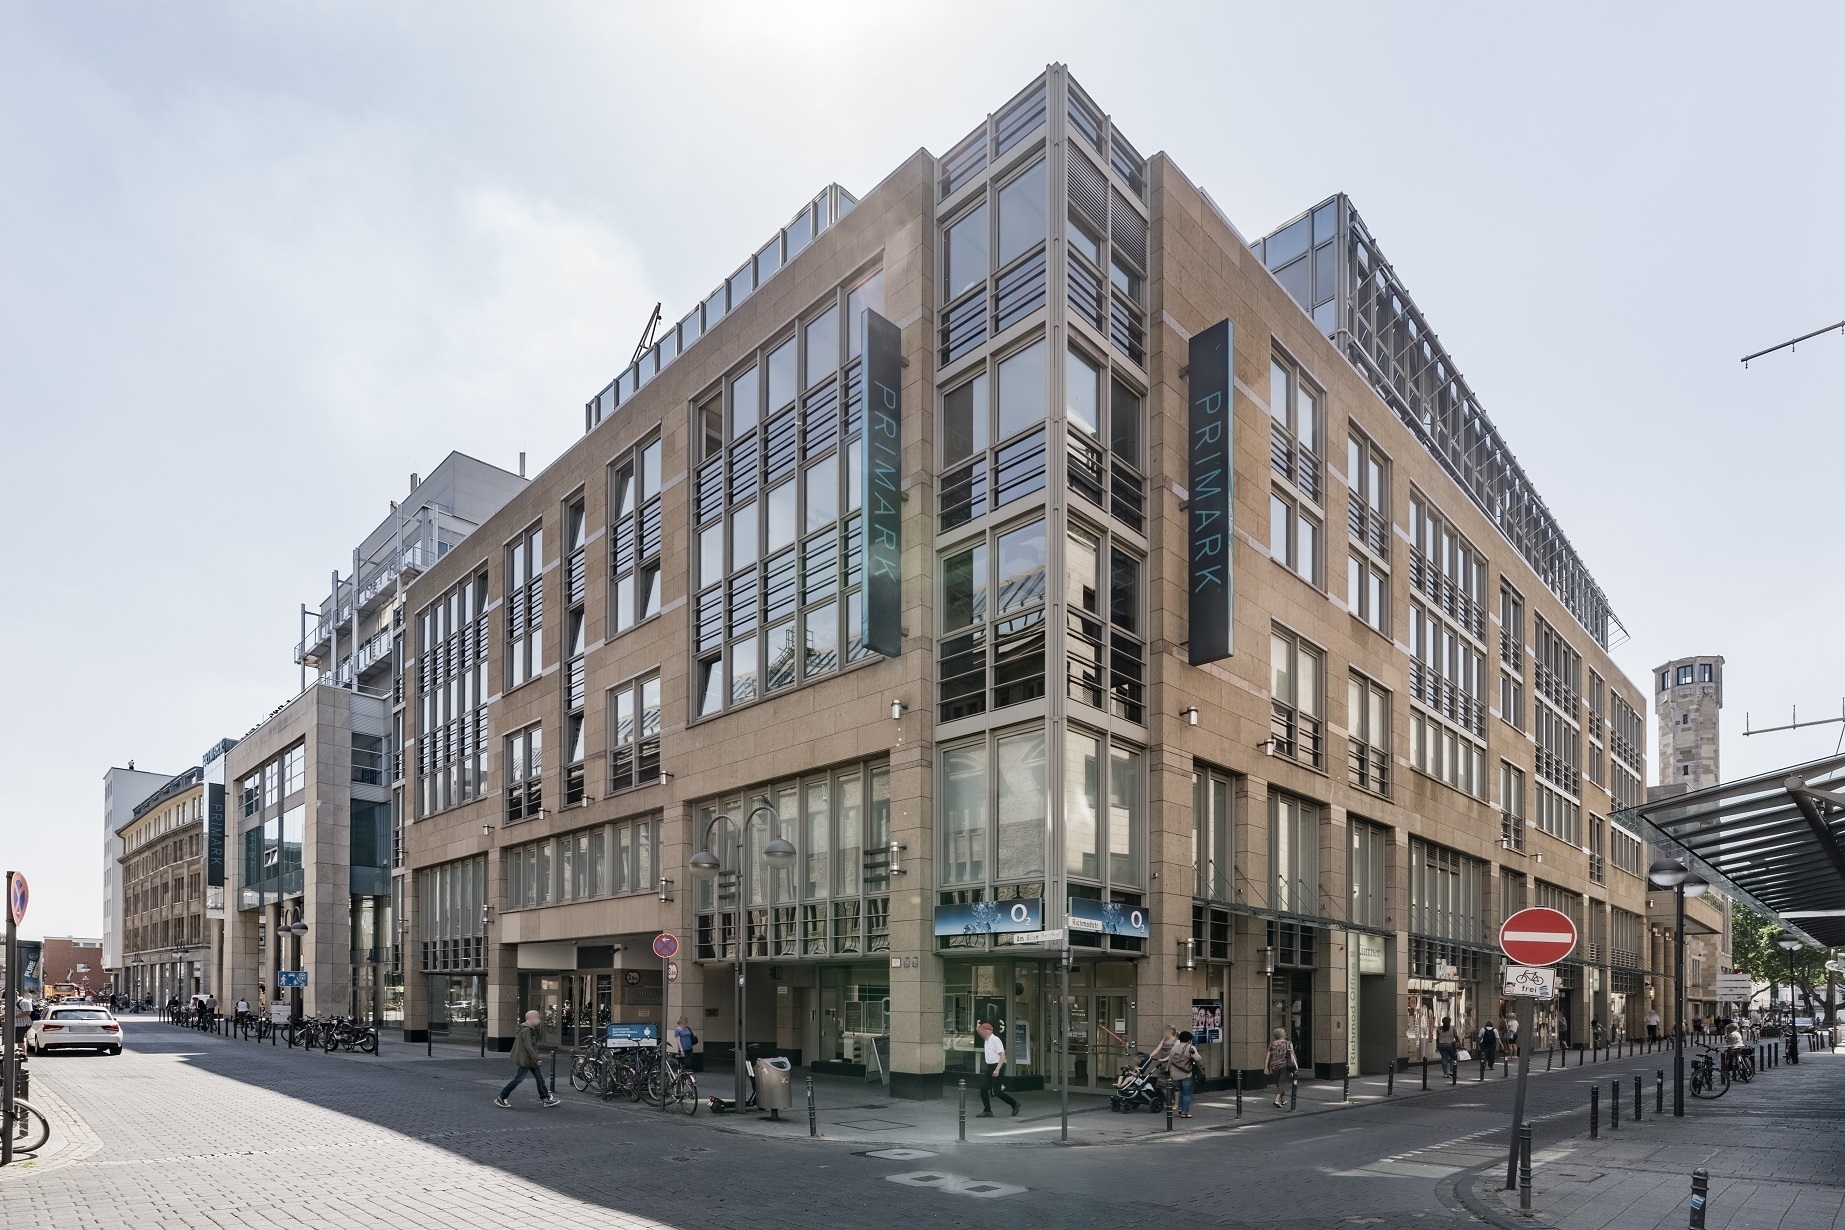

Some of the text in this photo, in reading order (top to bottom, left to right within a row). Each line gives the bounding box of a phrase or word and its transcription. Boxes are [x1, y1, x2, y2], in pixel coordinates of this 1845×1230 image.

[874, 380, 896, 583] PRIMARK
[1195, 391, 1222, 593] PRIMARK
[210, 803, 223, 865] PRIMARK
[24, 961, 36, 977] PURE
[1360, 943, 1381, 957] üttner
[1521, 985, 1537, 993] frei
